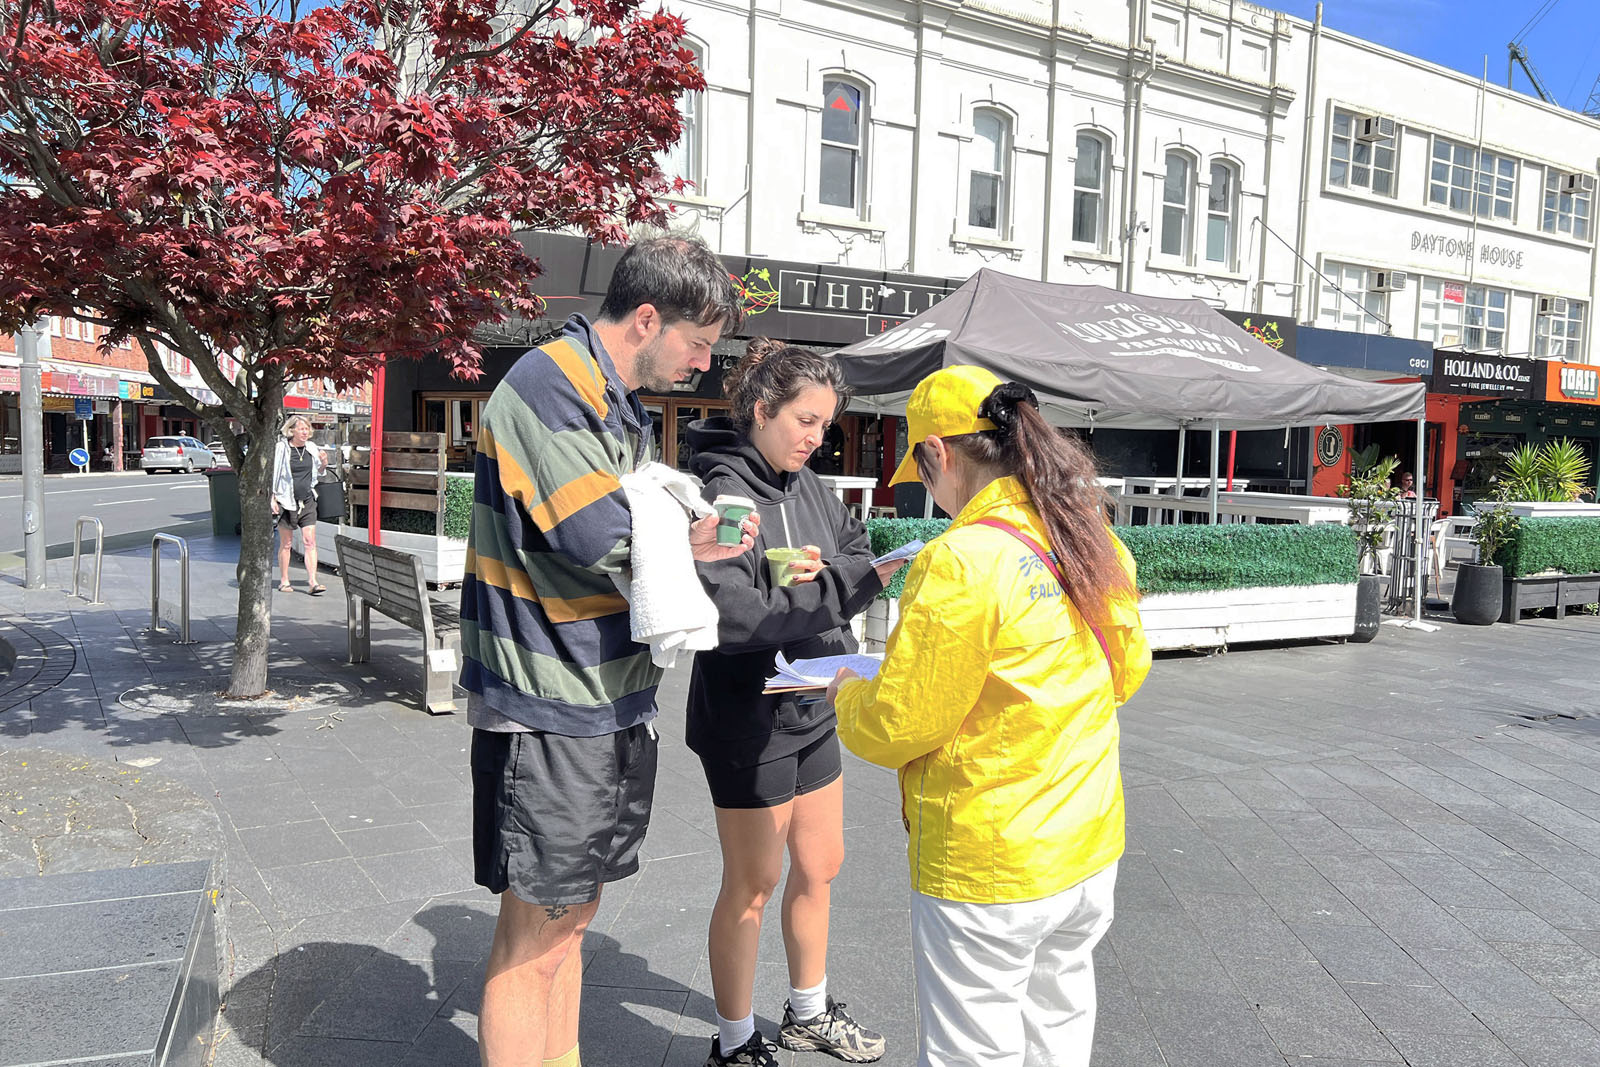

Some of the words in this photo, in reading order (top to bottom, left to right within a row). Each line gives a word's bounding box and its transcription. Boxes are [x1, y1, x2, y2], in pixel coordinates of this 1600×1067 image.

[1480, 244, 1524, 269] HOUSE
[795, 279, 875, 311] THE
[1116, 336, 1228, 355] FREEHOUSE
[1560, 367, 1597, 391] TOAST
